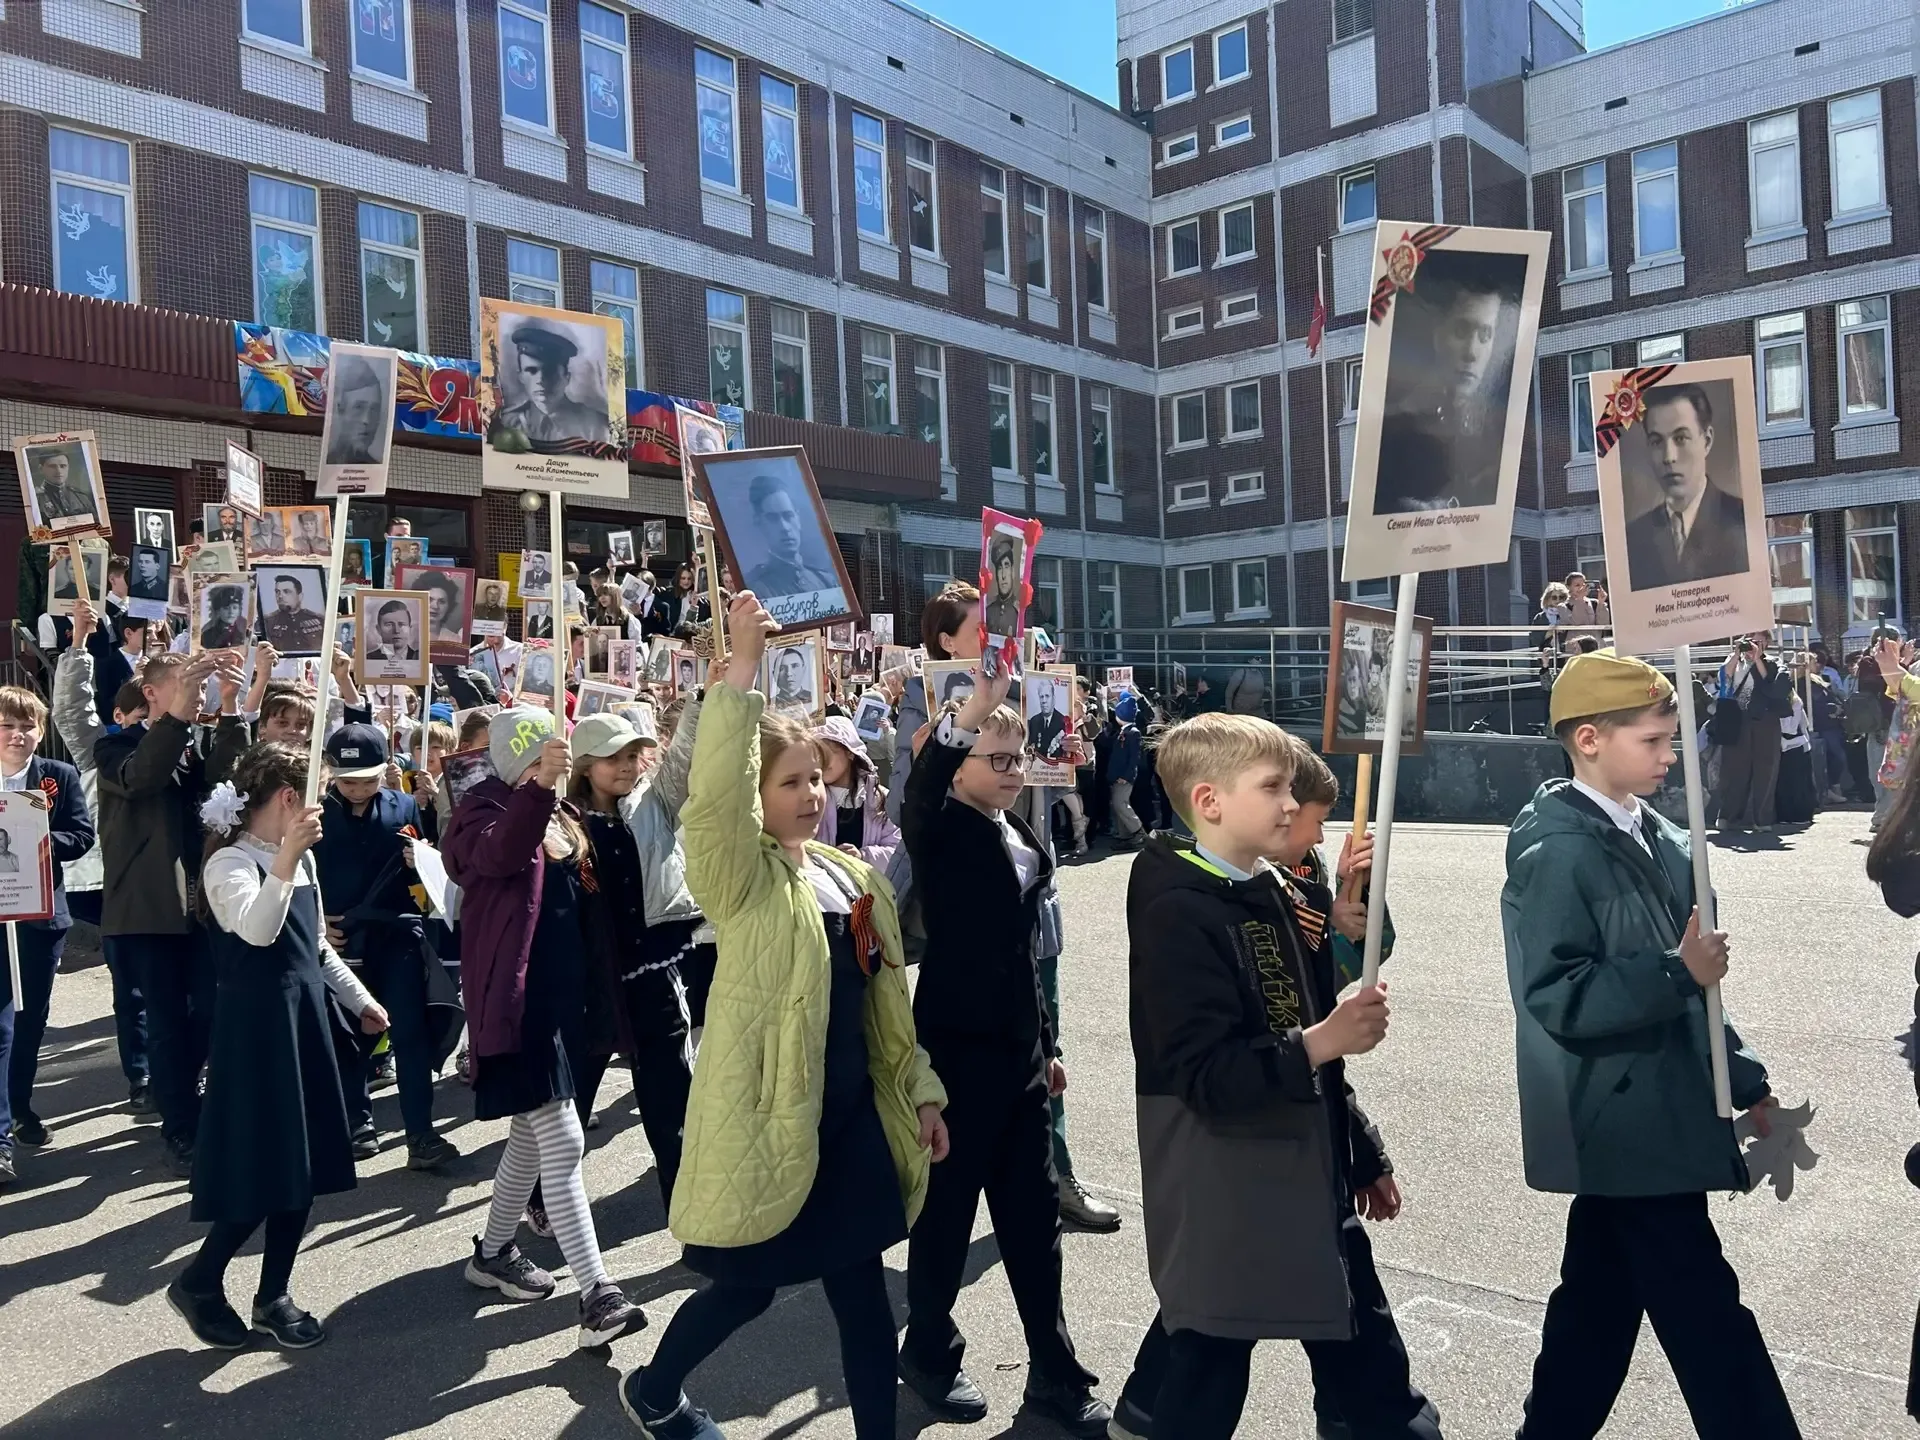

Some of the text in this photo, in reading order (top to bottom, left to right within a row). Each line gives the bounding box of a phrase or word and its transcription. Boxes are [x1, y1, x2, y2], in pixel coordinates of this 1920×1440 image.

[428, 367, 471, 424] 9
[515, 463, 600, 479] Алексей Климентьевич
[1387, 512, 1481, 531] Сенин Иван Федорович
[1671, 585, 1711, 599] Четверня
[1655, 594, 1730, 614] Иван Никифорович
[1648, 605, 1740, 629] Майор медицинской службы
